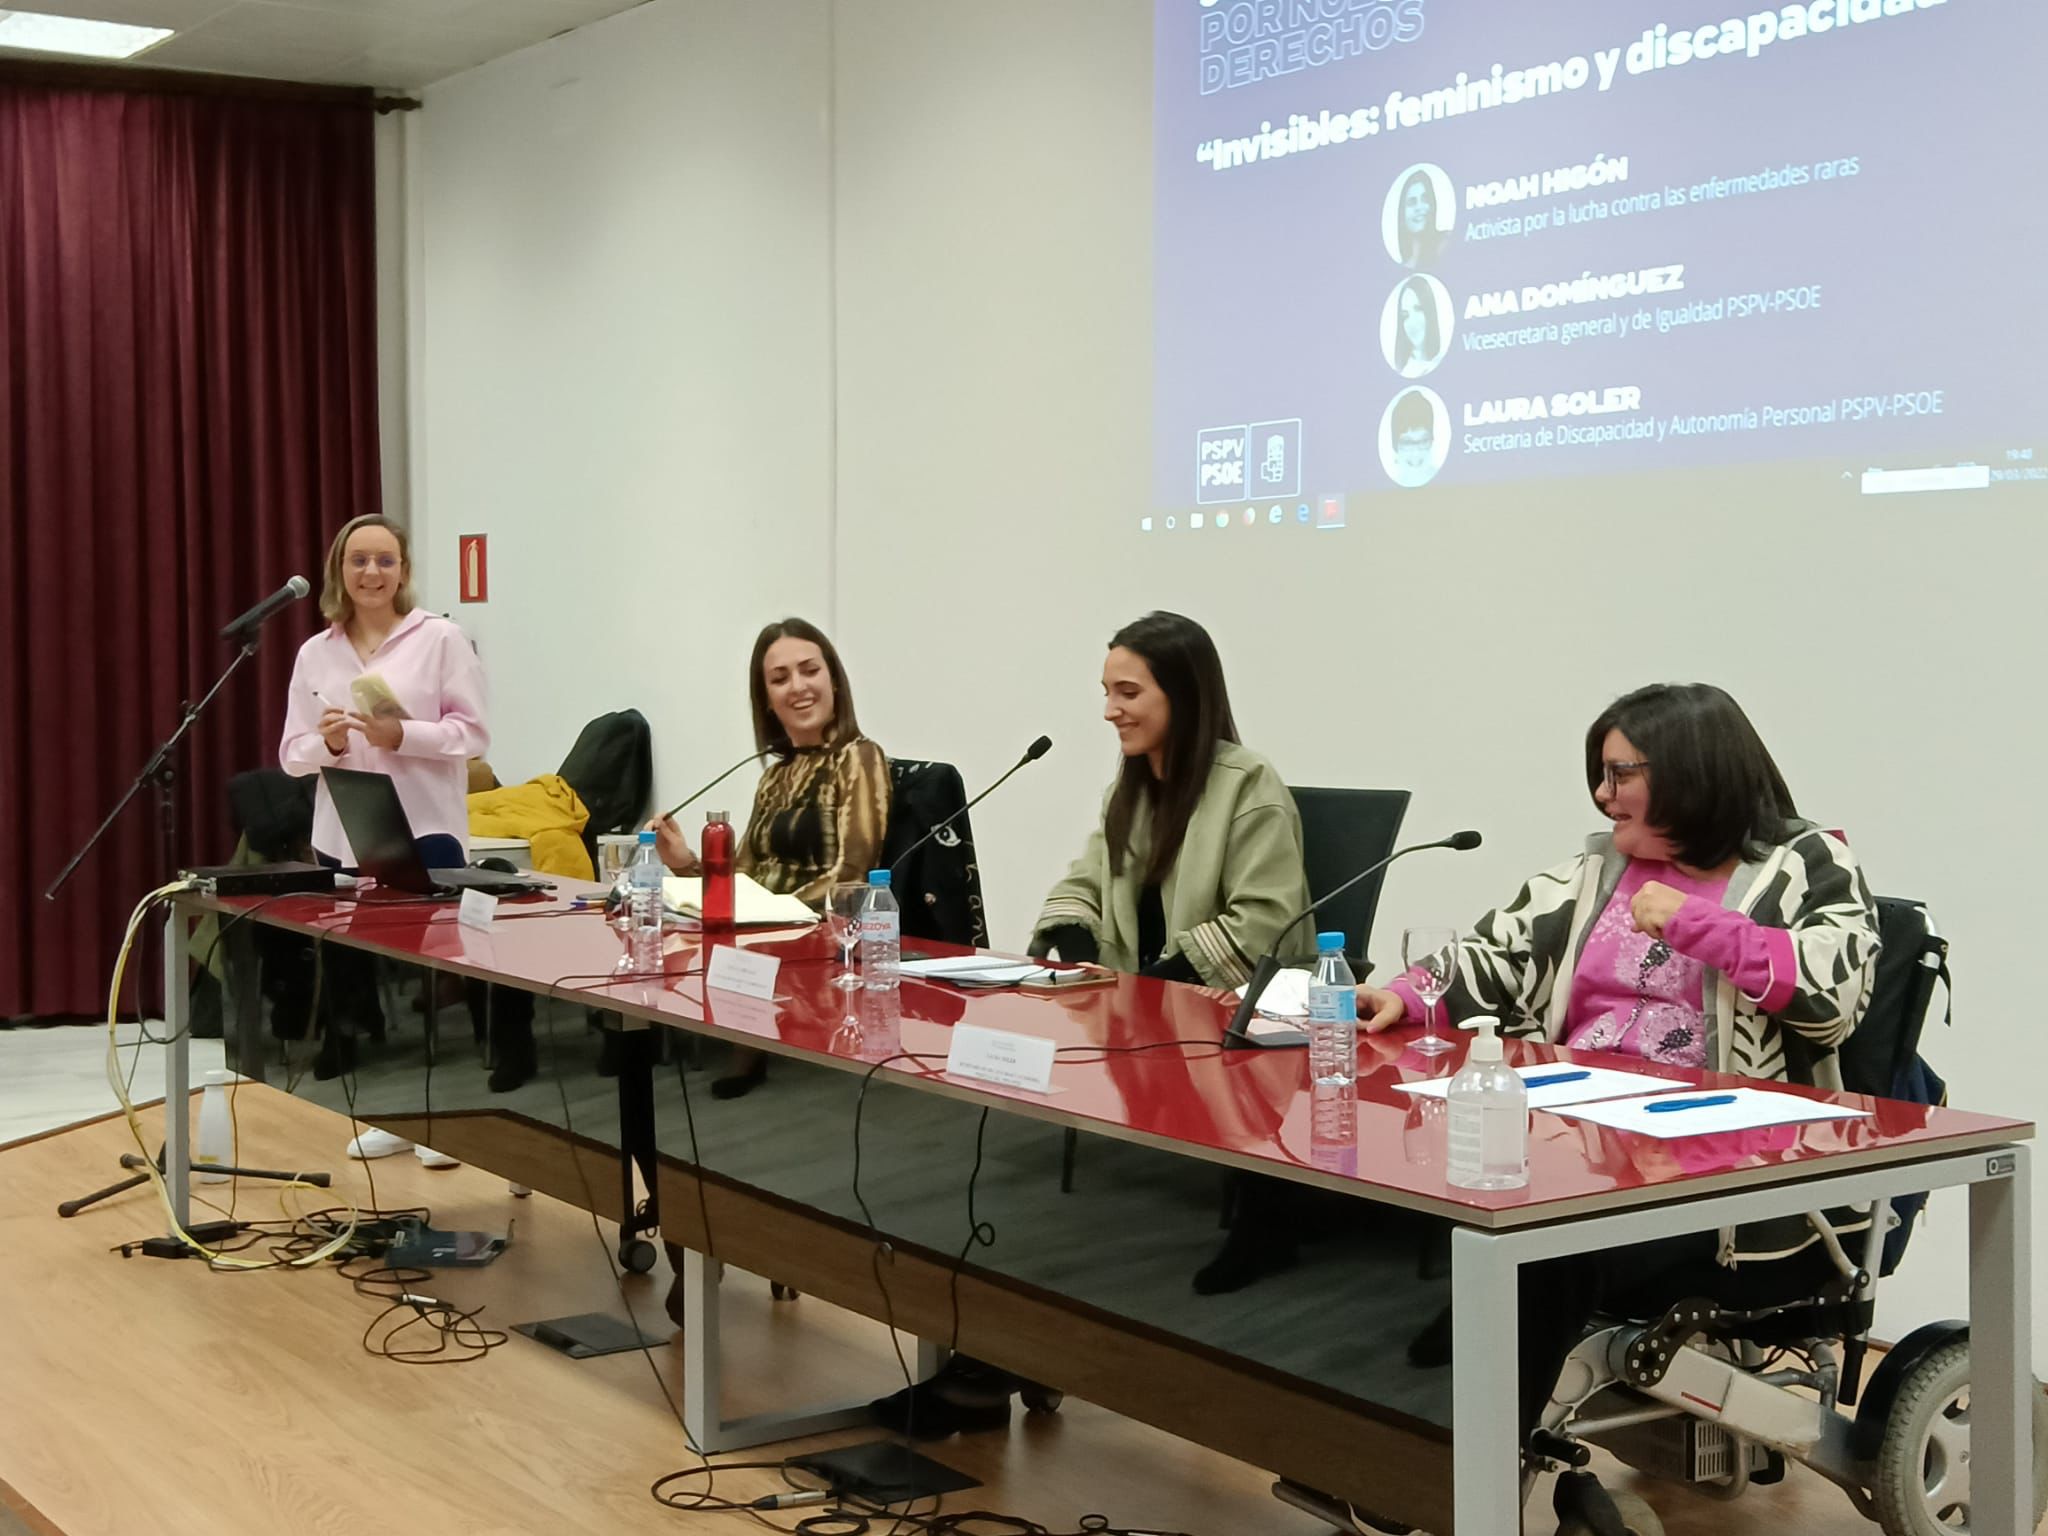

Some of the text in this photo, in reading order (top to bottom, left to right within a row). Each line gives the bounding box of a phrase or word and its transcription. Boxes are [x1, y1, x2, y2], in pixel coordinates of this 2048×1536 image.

[1200, 0, 1283, 53] POR
[1200, 0, 1425, 96] DERECHOS
[1385, 56, 1590, 131] feminismo
[1594, 47, 1621, 91] y
[1465, 156, 1860, 242] Activista por la lucha contra las enfermedades raras
[1466, 153, 1628, 210] NOAH HIGÓN
[1462, 285, 1822, 351] Vicesecretaria general y de Igualdad PSPV-PSOE
[1464, 264, 1684, 320] ANA DOMÍNGUEZ
[1463, 389, 1944, 454] Secretaria de Discapacidad y Autonomía Personal PSPV-PSOE
[1464, 385, 1641, 426] LAURA SOLER
[1200, 461, 1244, 487] PSOE
[1201, 437, 1245, 461] PSPV
